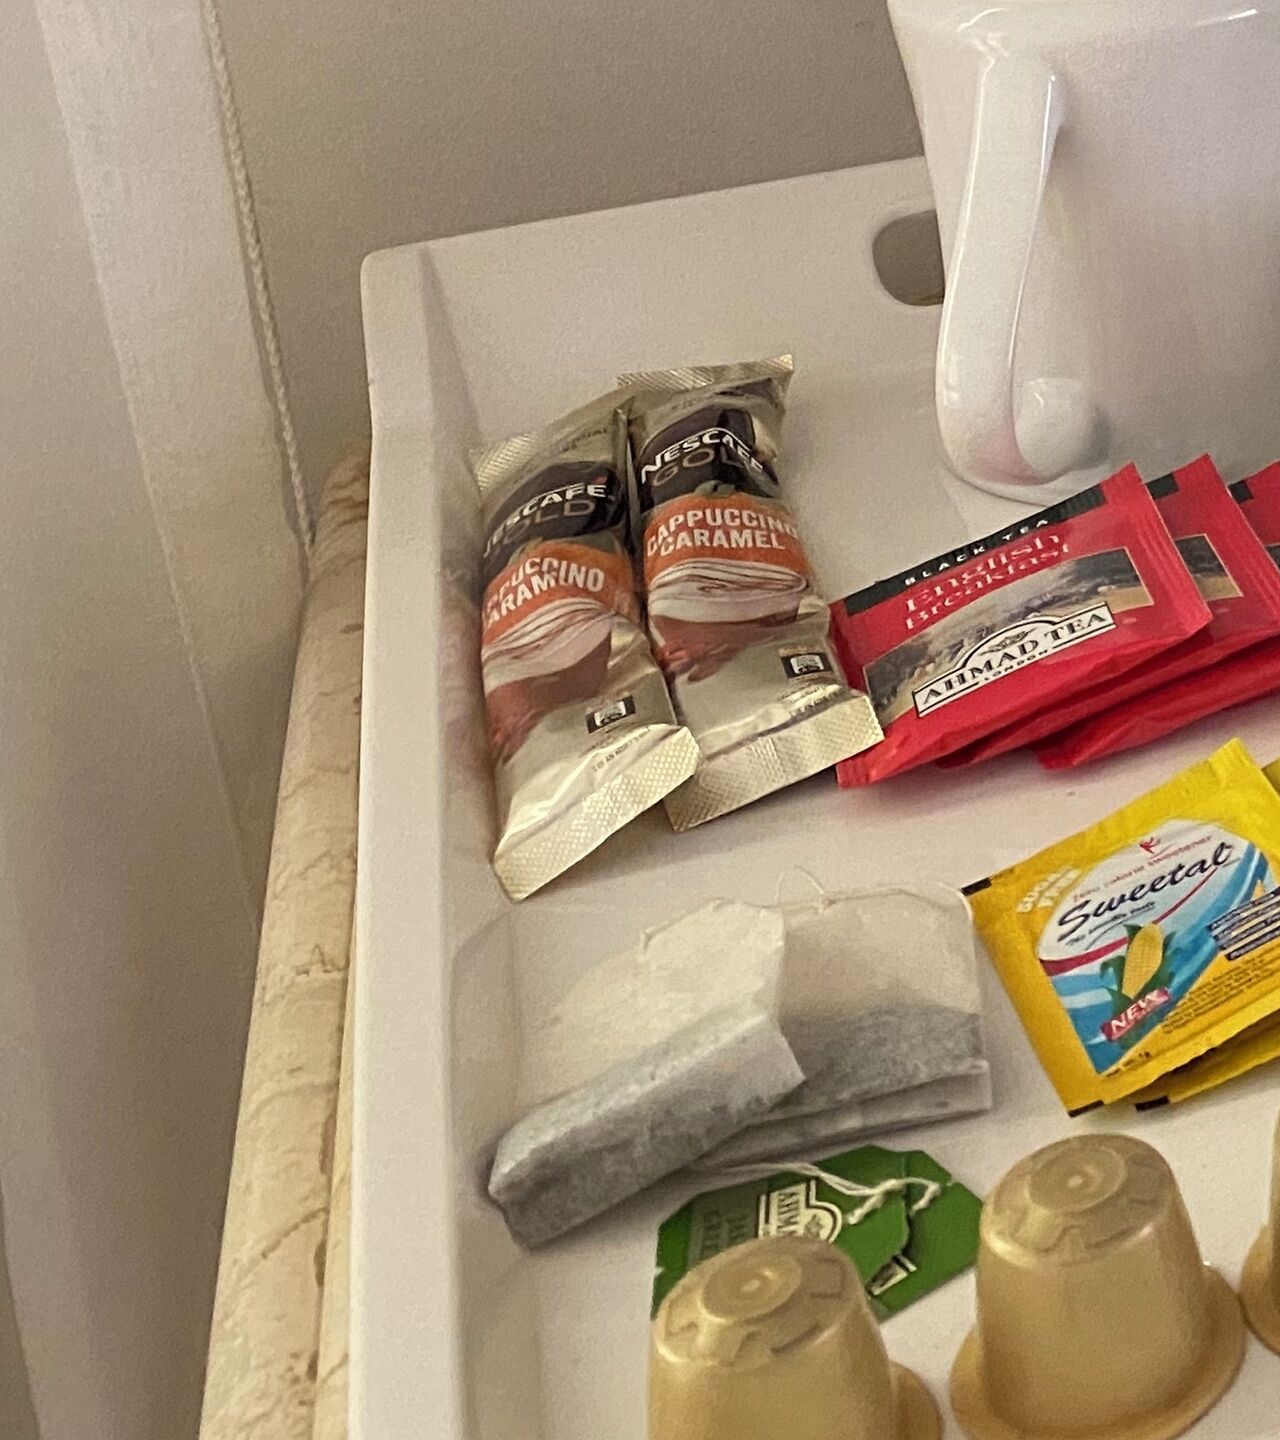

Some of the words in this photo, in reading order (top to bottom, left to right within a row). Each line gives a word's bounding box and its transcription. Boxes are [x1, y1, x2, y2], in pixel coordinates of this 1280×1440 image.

[501, 498, 597, 546] OLD
[647, 508, 798, 557] CAPPUCCINO
[660, 528, 787, 557] CARAMEL
[904, 545, 986, 586] BLACK
[1001, 518, 1049, 541] TEA
[905, 542, 1070, 630] Breakfast
[906, 534, 1060, 611] English
[922, 635, 1041, 705] AHMAD
[1043, 613, 1107, 642] TEA
[1056, 841, 1233, 943] Sweetal
[1109, 988, 1166, 1036] NEW
